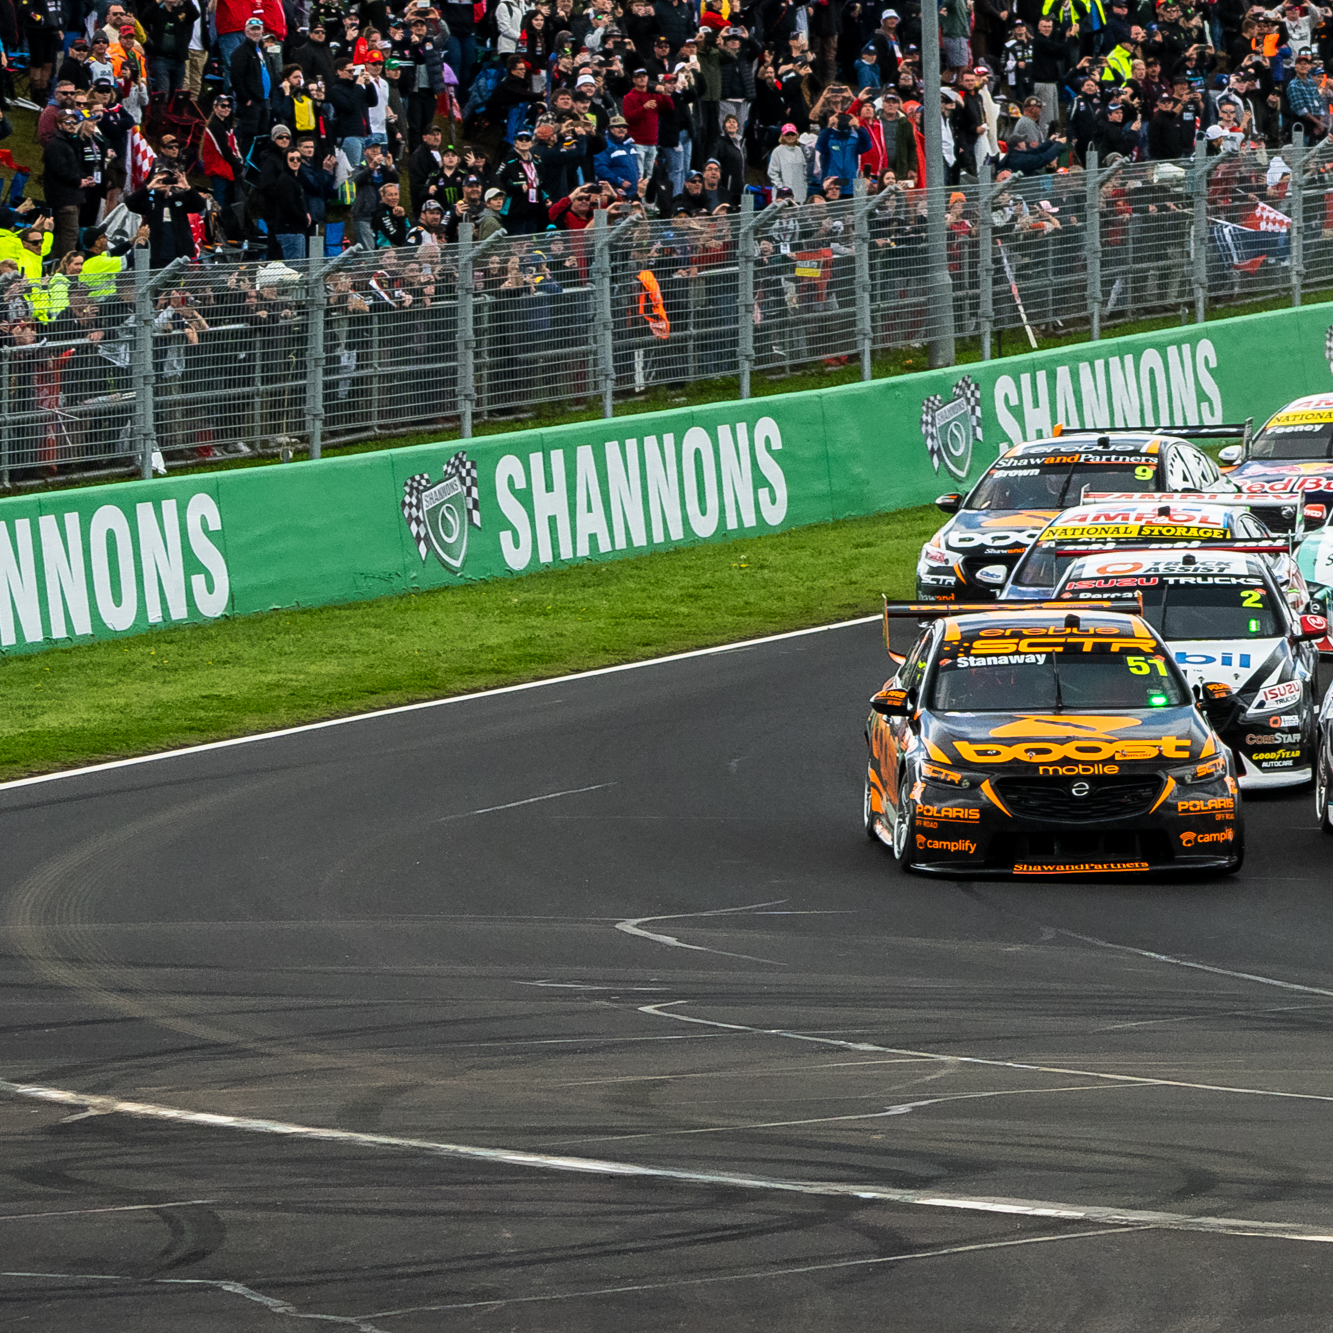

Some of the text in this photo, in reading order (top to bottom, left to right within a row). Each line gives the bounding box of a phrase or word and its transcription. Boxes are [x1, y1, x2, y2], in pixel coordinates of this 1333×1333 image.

[1266, 424, 1324, 435] Feeney
[996, 453, 1158, 468] ShawandPartners
[995, 467, 1041, 479] Brown
[1135, 466, 1154, 481] 9
[424, 478, 460, 509] SHANNONS
[495, 416, 787, 571] SHANNONS
[1048, 526, 1225, 538] NATIONAL STORAGE
[920, 575, 956, 587] SCTR
[1065, 576, 1263, 590] ISUZU TRUCKS
[1240, 590, 1263, 608] 2
[969, 637, 1157, 654] SCTR
[956, 653, 1047, 668] Stanaway
[1126, 656, 1169, 677] 51
[953, 736, 1192, 763] boost
[922, 763, 962, 784] SCTR
[1039, 764, 1120, 775] mobile
[916, 805, 980, 819] POLARIS
[1178, 798, 1234, 812] POLARIS
[926, 839, 977, 855] camplify
